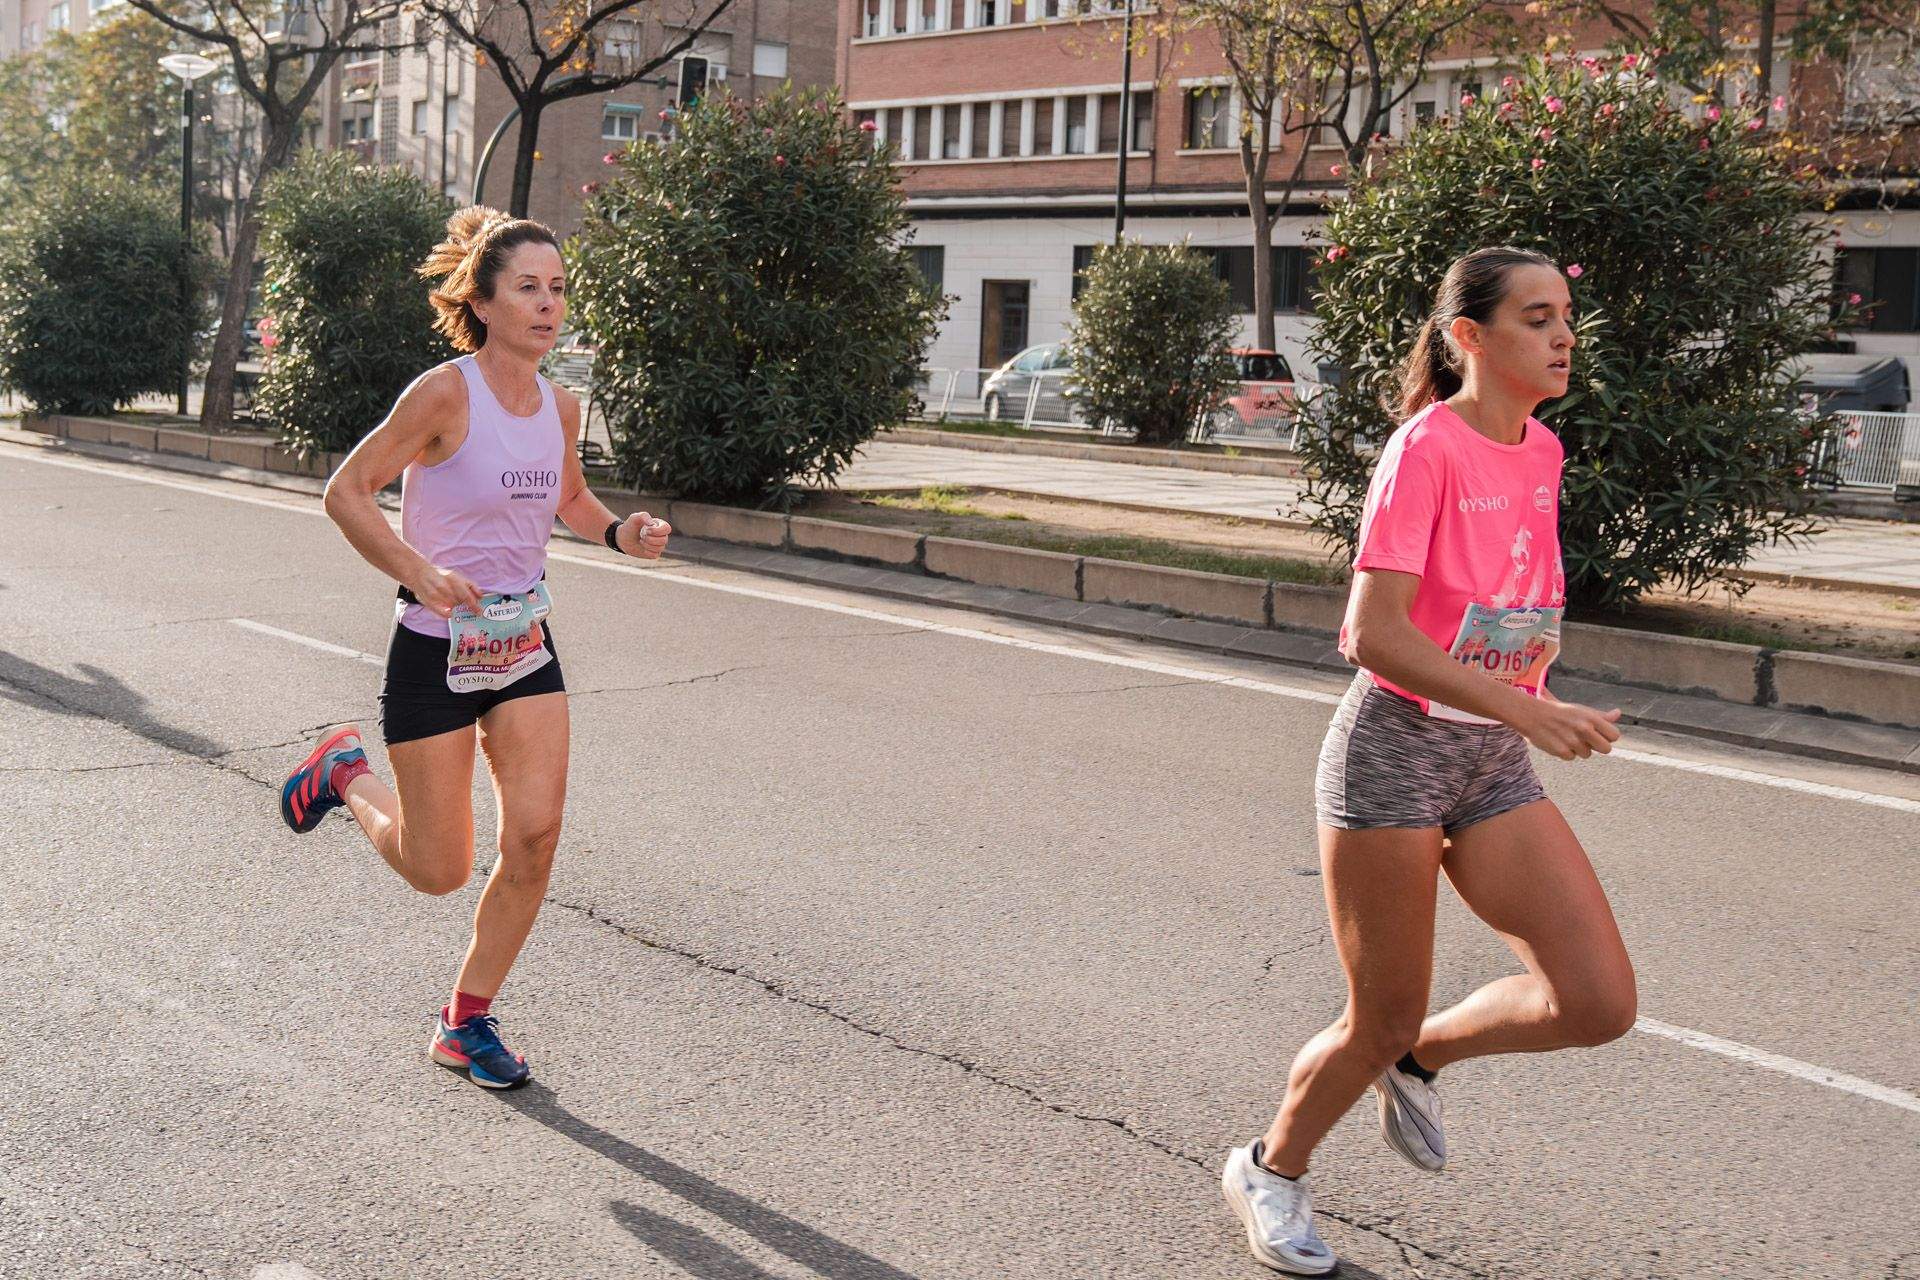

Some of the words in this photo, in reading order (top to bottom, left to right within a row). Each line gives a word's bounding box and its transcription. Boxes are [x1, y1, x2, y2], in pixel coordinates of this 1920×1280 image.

[501, 471, 557, 488] OYSHO
[1458, 495, 1509, 512] OYSHO
[1483, 648, 1522, 671] 016
[458, 676, 494, 686] OYSHO
